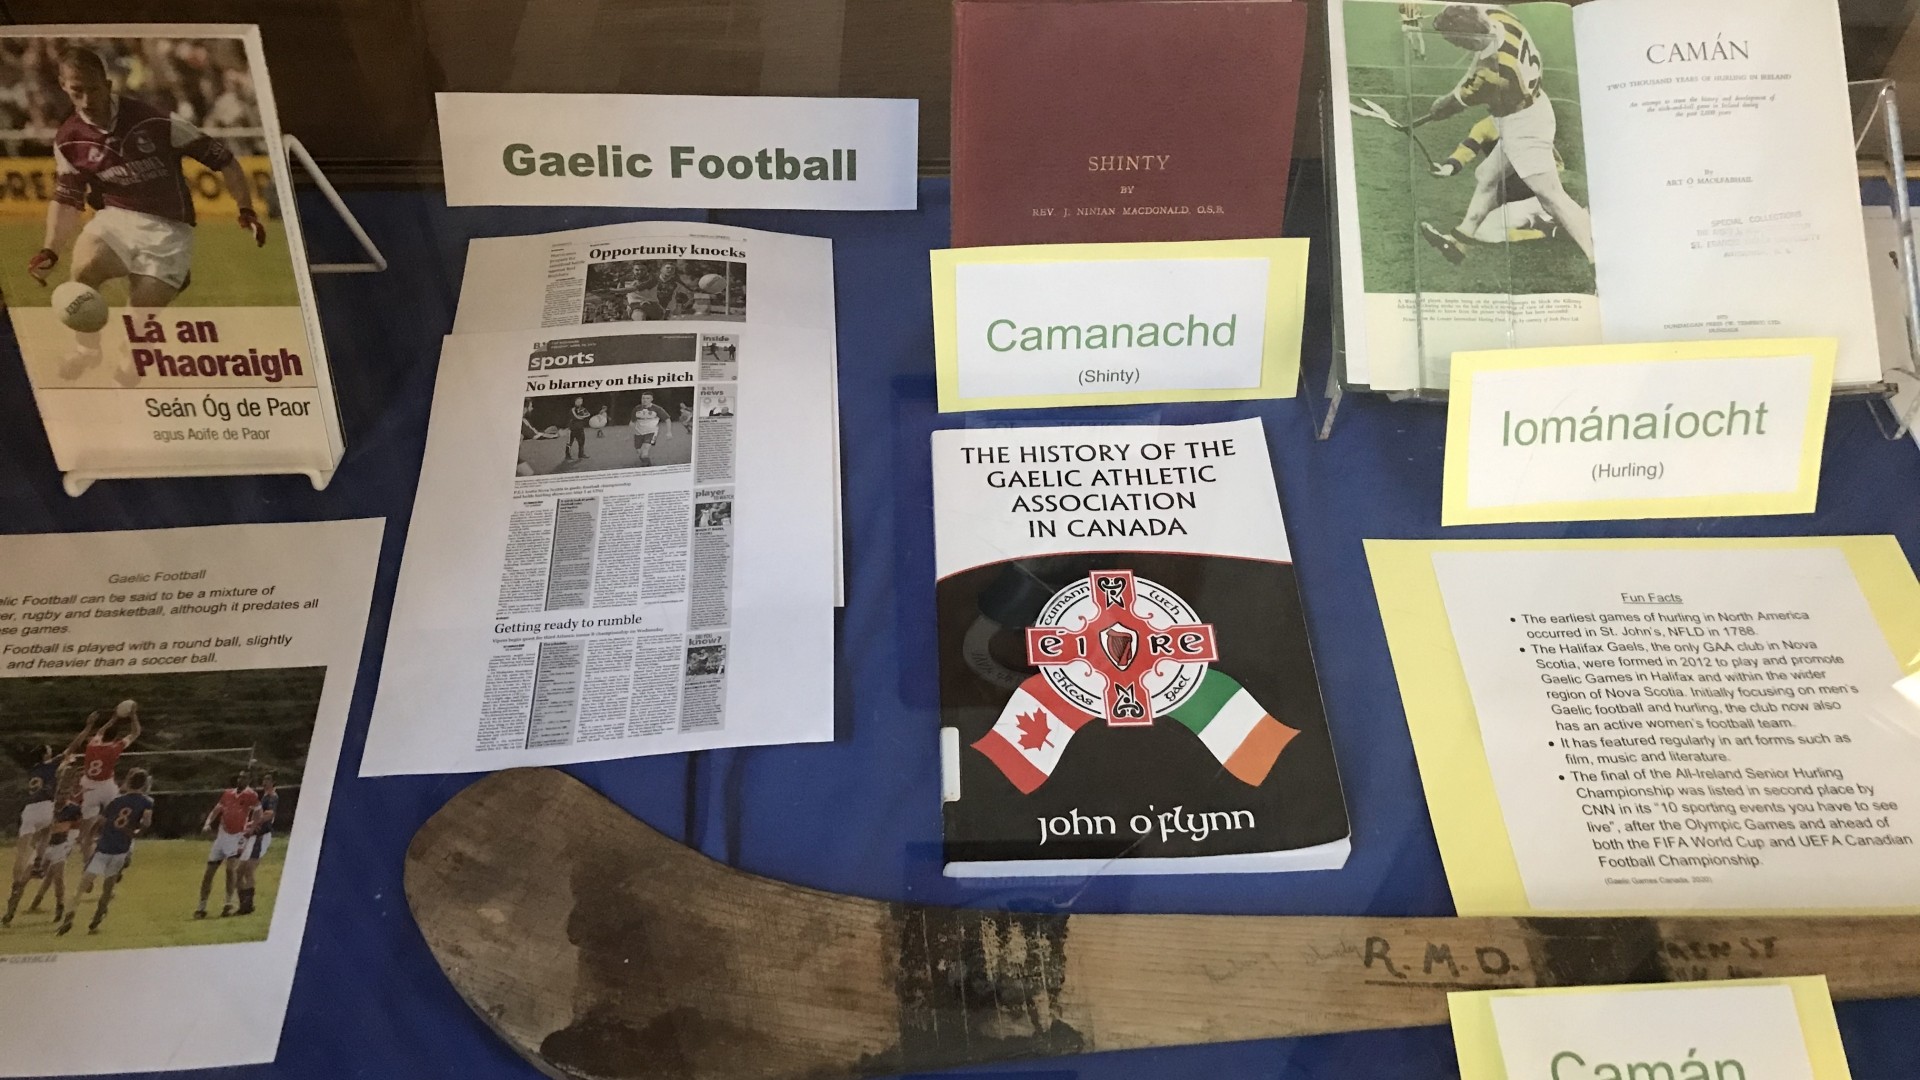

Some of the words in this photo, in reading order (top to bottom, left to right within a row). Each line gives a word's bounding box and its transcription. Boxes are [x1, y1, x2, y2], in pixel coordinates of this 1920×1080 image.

[1646, 32, 1750, 64] CAMÁN
[502, 143, 653, 179] Gaelic
[670, 146, 857, 181] Football
[1088, 155, 1171, 172] SHINTY
[1120, 186, 1135, 194] BY
[1064, 208, 1071, 218] J.
[1076, 207, 1116, 216] NINIAN
[589, 244, 687, 261] Opportunity
[691, 244, 746, 259] knocks
[122, 314, 167, 343] Lá
[176, 320, 219, 343] an
[987, 314, 1237, 352] Camanachd
[132, 348, 303, 383] Phaoraigh
[530, 352, 595, 370] sports
[526, 382, 546, 392] No
[549, 378, 603, 392] blarney
[606, 377, 623, 387] on
[628, 374, 653, 385] this
[657, 372, 694, 386] pitch
[1078, 368, 1140, 386] (Shinty)
[146, 398, 197, 418] Seán
[203, 394, 231, 422] Óg
[237, 398, 262, 417] de
[267, 398, 311, 417] Paor
[1503, 401, 1768, 446] Iománaíocht
[153, 430, 184, 443] agus
[188, 428, 219, 441] Aoife
[223, 429, 239, 441] de
[242, 428, 270, 440] Paor
[961, 447, 1010, 464] THE
[1020, 444, 1130, 463] HISTORY
[1141, 442, 1177, 461] OF
[1185, 440, 1236, 458] THE
[987, 470, 1082, 488] GAELIC
[1091, 465, 1216, 486] ATHLETIC
[1592, 462, 1665, 482] (Hurling)
[695, 489, 726, 499] player
[1011, 492, 1196, 513] ASSOCIATION
[1029, 520, 1056, 538] IN
[1067, 518, 1188, 538] CANADA
[108, 573, 150, 583] Gaelic
[154, 569, 206, 581] Football
[22, 595, 77, 605] Football
[80, 595, 105, 603] can
[109, 593, 126, 603] be
[129, 592, 158, 602] said
[161, 592, 173, 600] to
[177, 590, 194, 599] be
[197, 590, 206, 598] a
[210, 588, 257, 597] mixture
[261, 585, 275, 595] of
[1621, 593, 1646, 604] Fun
[1648, 592, 1684, 604] Facts
[22, 610, 61, 621] rugby
[65, 609, 91, 618] and
[94, 606, 164, 617] basketball,
[170, 603, 227, 614] although
[231, 602, 239, 611] it
[242, 601, 299, 612] predates
[303, 598, 318, 608] all
[1521, 614, 1546, 623] The
[1550, 613, 1596, 623] earliest
[1599, 614, 1640, 623] games
[1643, 612, 1655, 622] of
[1658, 613, 1701, 624] hurling
[1702, 613, 1715, 621] in
[1717, 612, 1753, 621] North
[1758, 611, 1809, 620] America
[21, 626, 71, 637] games.
[494, 623, 542, 634] Getting
[544, 619, 578, 632] ready
[582, 619, 594, 628] to
[597, 615, 642, 627] rumble
[1527, 628, 1581, 638] occurred
[1584, 628, 1597, 637] in
[1600, 627, 1617, 636] St.
[1622, 627, 1665, 637] John's,
[1667, 627, 1704, 636] NFLD
[1707, 627, 1720, 636] in
[1723, 626, 1759, 636] 1788.
[3, 643, 59, 654] Football
[62, 643, 74, 652] is
[77, 642, 125, 654] played
[128, 641, 155, 650] with
[159, 641, 168, 650] a
[172, 638, 212, 649] round
[214, 637, 241, 647] ball,
[246, 635, 292, 647] slightly
[689, 636, 722, 646] know?
[1531, 644, 1556, 654] The
[1559, 643, 1603, 653] Halifax
[1607, 642, 1648, 651] Gaels,
[1650, 642, 1671, 651] the
[1674, 643, 1699, 654] only
[1703, 642, 1734, 652] GAA
[1737, 641, 1764, 651] club
[1766, 641, 1780, 650] in
[1782, 640, 1817, 649] Nova
[6, 659, 35, 669] and
[37, 658, 90, 668] heavier
[94, 657, 124, 667] than
[127, 658, 137, 666] a
[141, 656, 187, 665] soccer
[190, 653, 217, 663] ball.
[1555, 720, 1579, 731] has
[1583, 723, 1600, 731] an
[1604, 720, 1642, 730] active
[1646, 719, 1703, 728] women's
[1706, 718, 1754, 728] football
[1757, 719, 1795, 728] team.
[88, 759, 104, 776] 8
[1565, 754, 1593, 765] film,
[1597, 753, 1637, 763] music
[1641, 752, 1666, 761] and
[1669, 752, 1731, 761] literature.
[114, 807, 133, 828] 8
[1551, 1048, 1746, 1080] Camán
